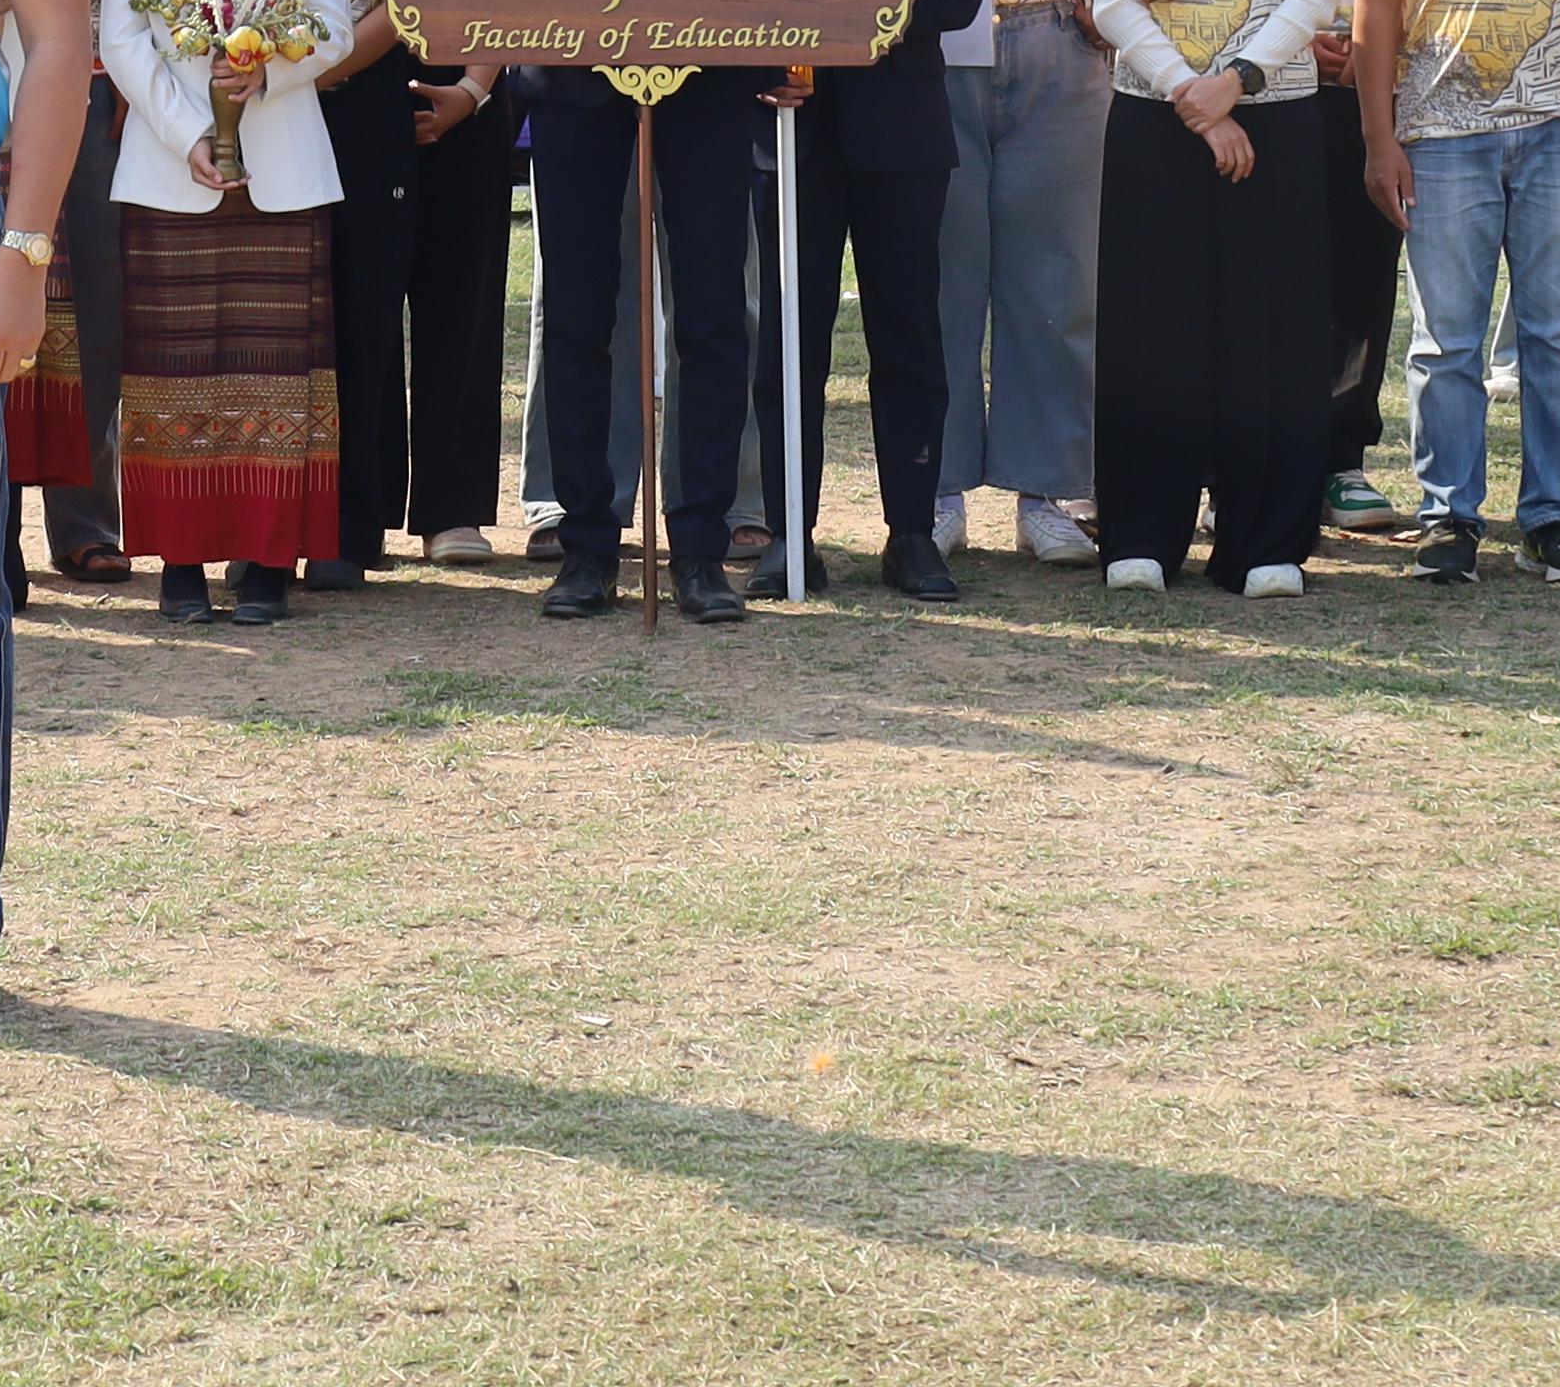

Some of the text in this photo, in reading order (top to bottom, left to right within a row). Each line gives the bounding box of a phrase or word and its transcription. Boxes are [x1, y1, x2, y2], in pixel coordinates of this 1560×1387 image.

[460, 18, 821, 59] Faculty of Education
